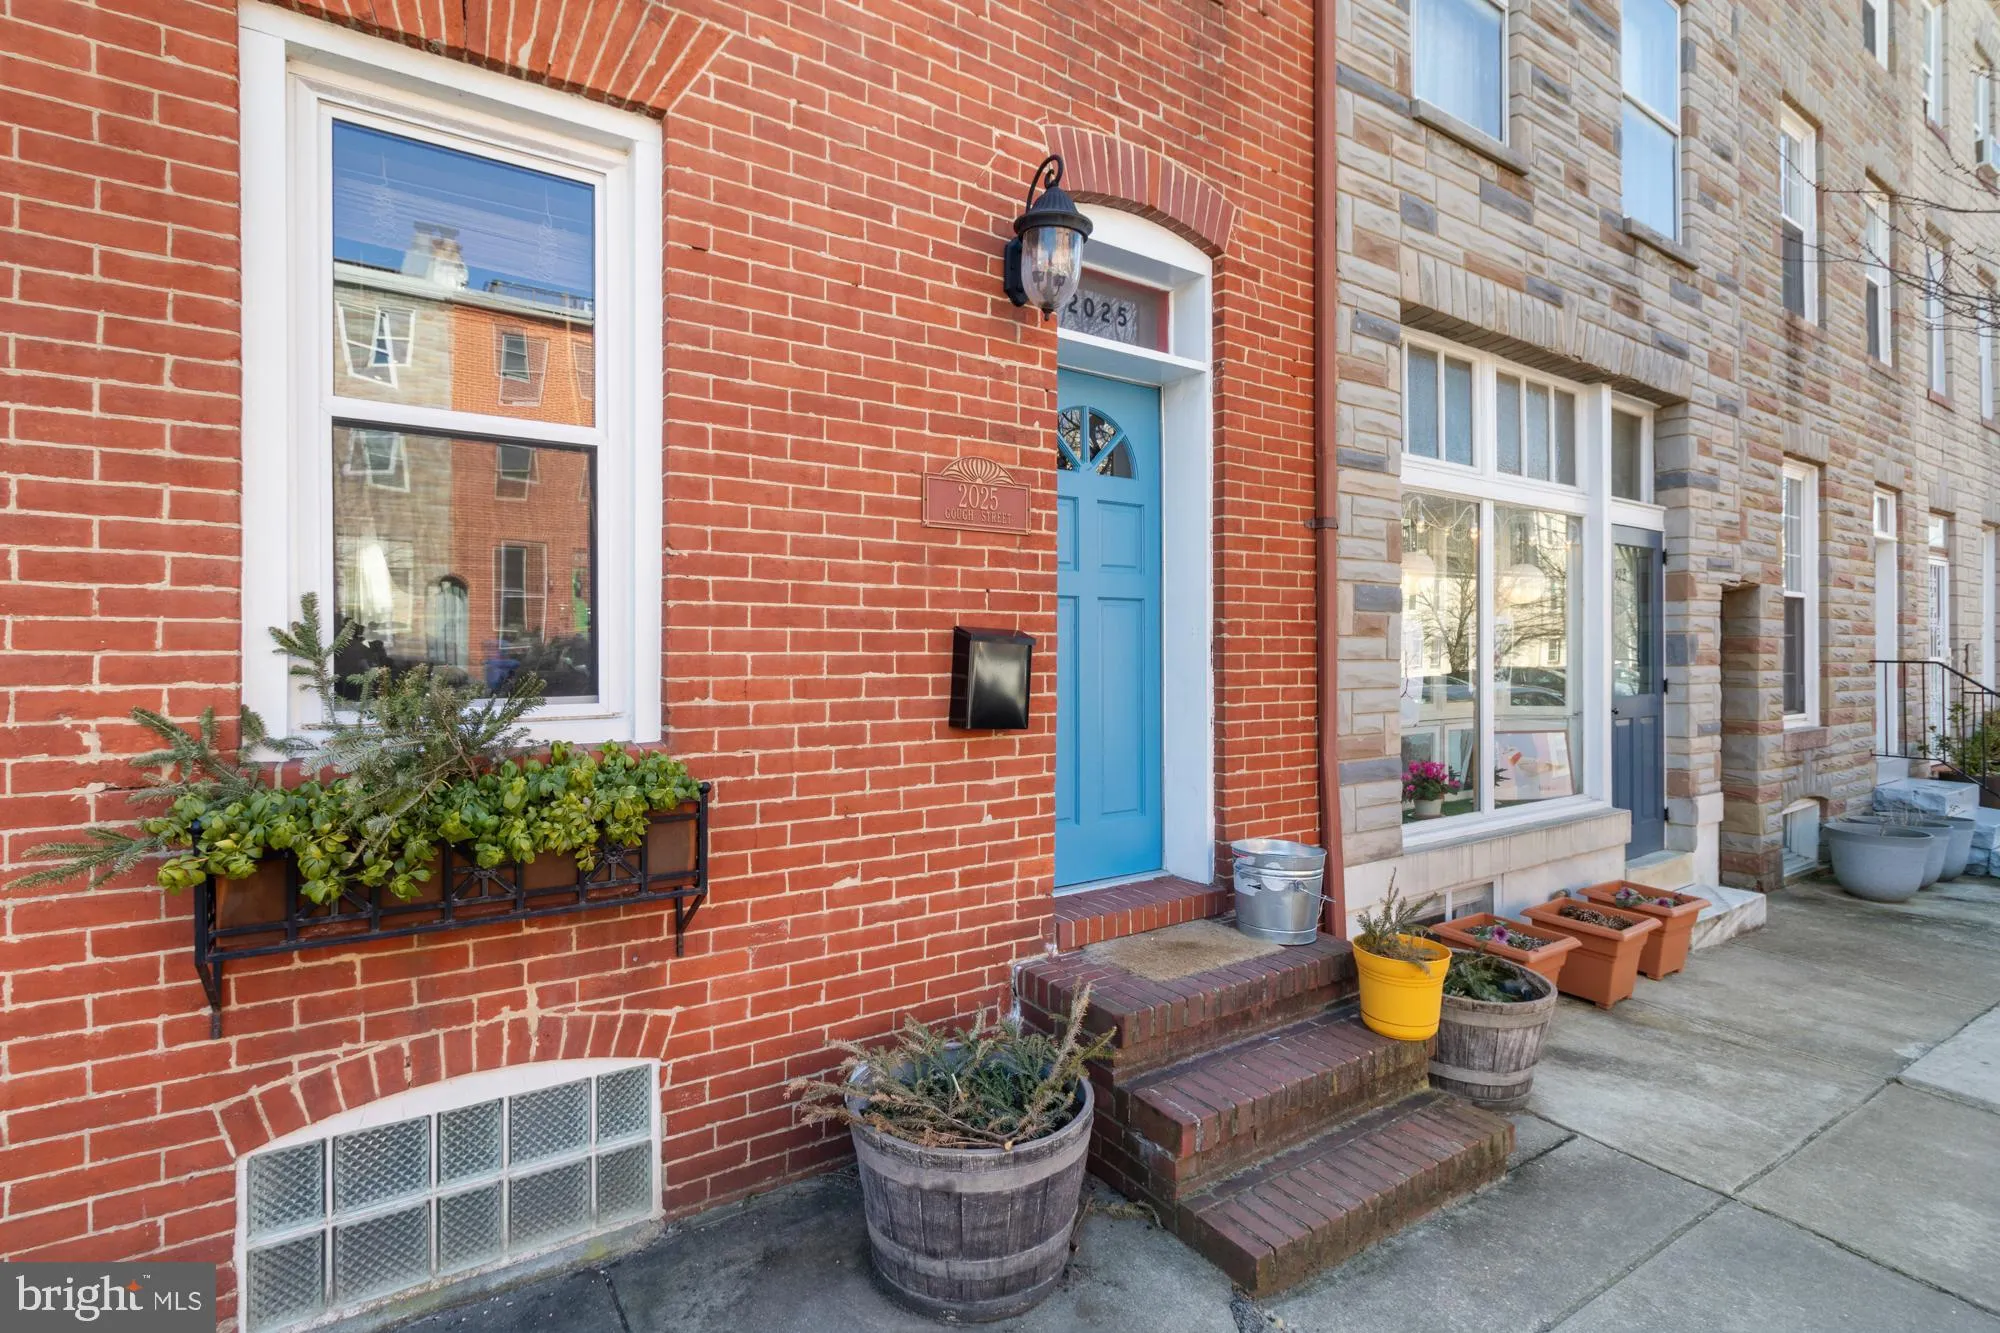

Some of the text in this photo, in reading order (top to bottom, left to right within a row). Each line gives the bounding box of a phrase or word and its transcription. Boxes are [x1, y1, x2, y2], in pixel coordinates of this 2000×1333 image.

[1068, 294, 1128, 327] 2025
[958, 484, 999, 511] 2025
[944, 507, 1012, 526] GOUGH STREET
